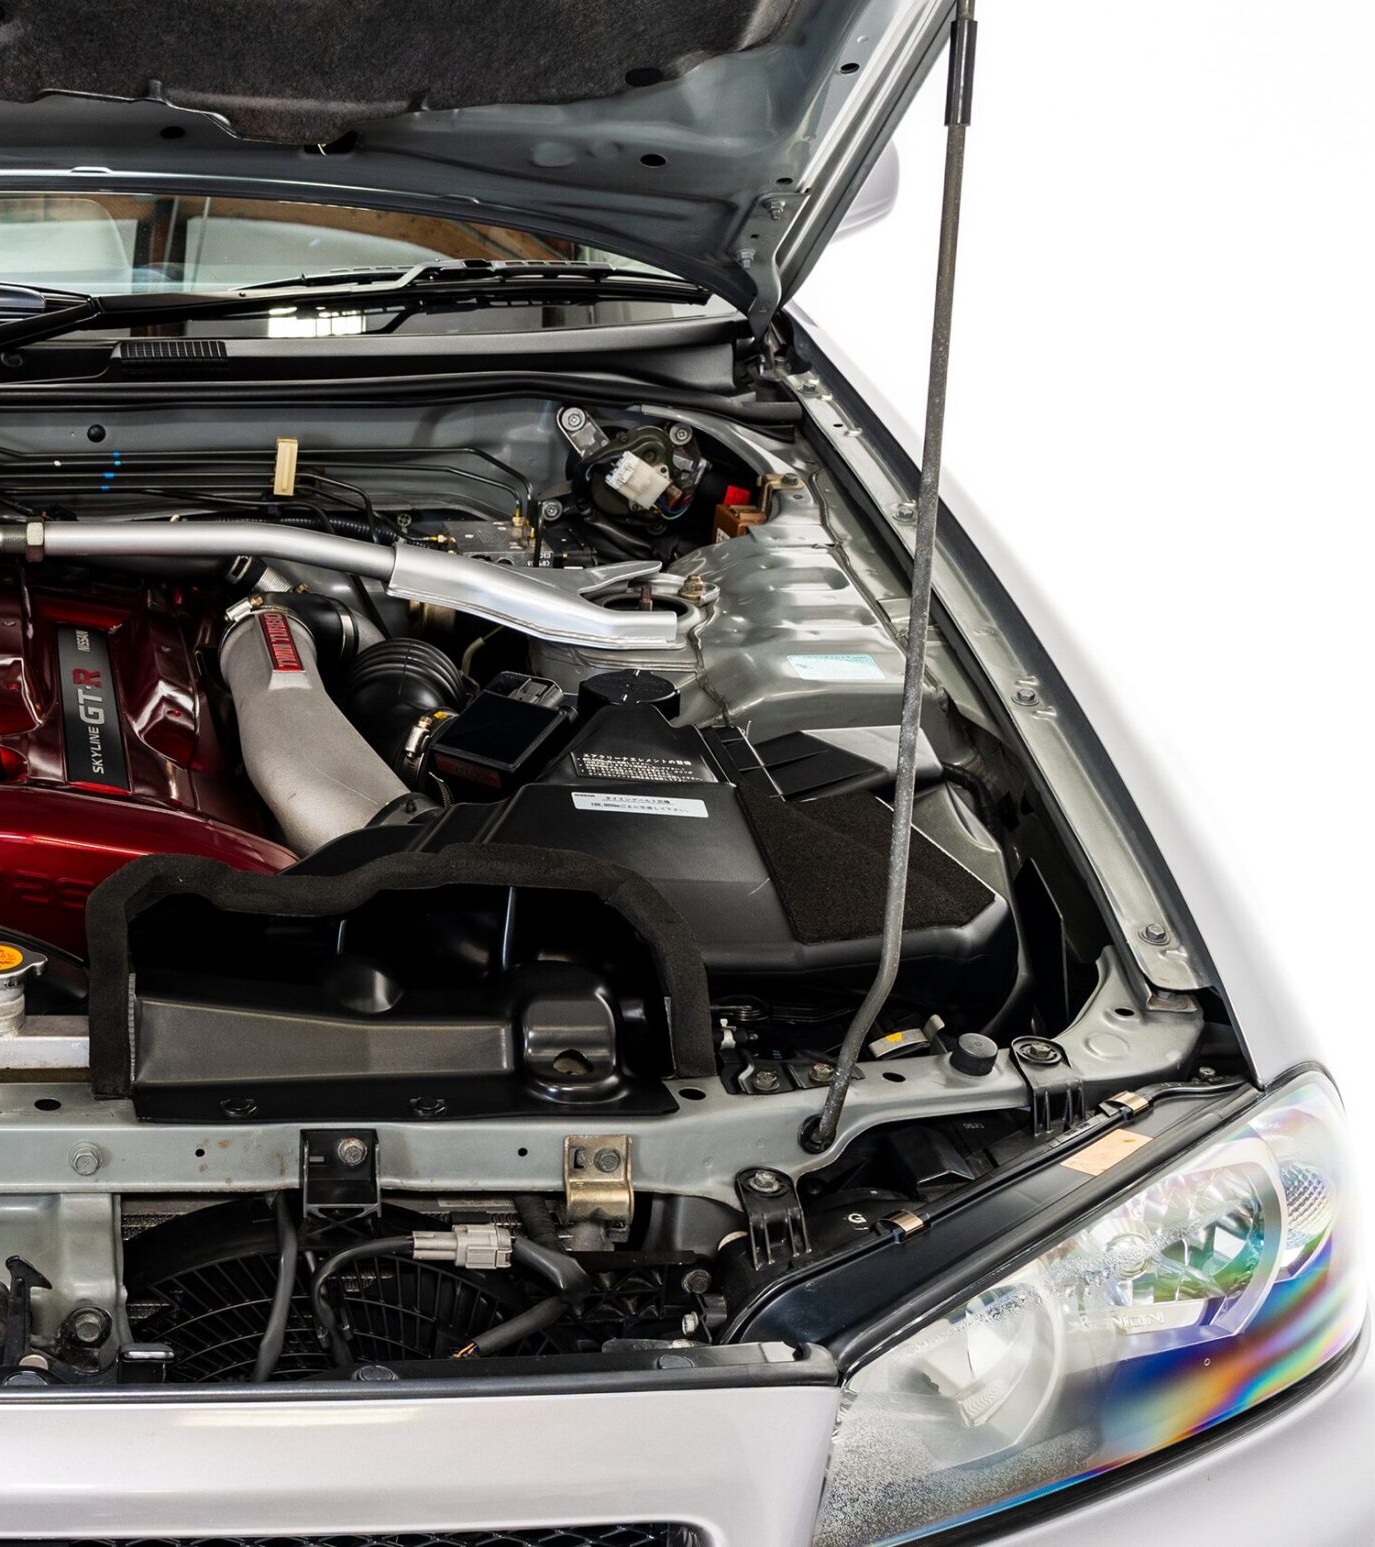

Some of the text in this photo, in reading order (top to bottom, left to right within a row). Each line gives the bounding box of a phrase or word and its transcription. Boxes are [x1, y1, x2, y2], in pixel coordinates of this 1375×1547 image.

[75, 629, 91, 652] NISSAN
[263, 613, 298, 667] TWIN TURBO
[88, 726, 104, 774] SKYLINE
[848, 1213, 867, 1223] G
